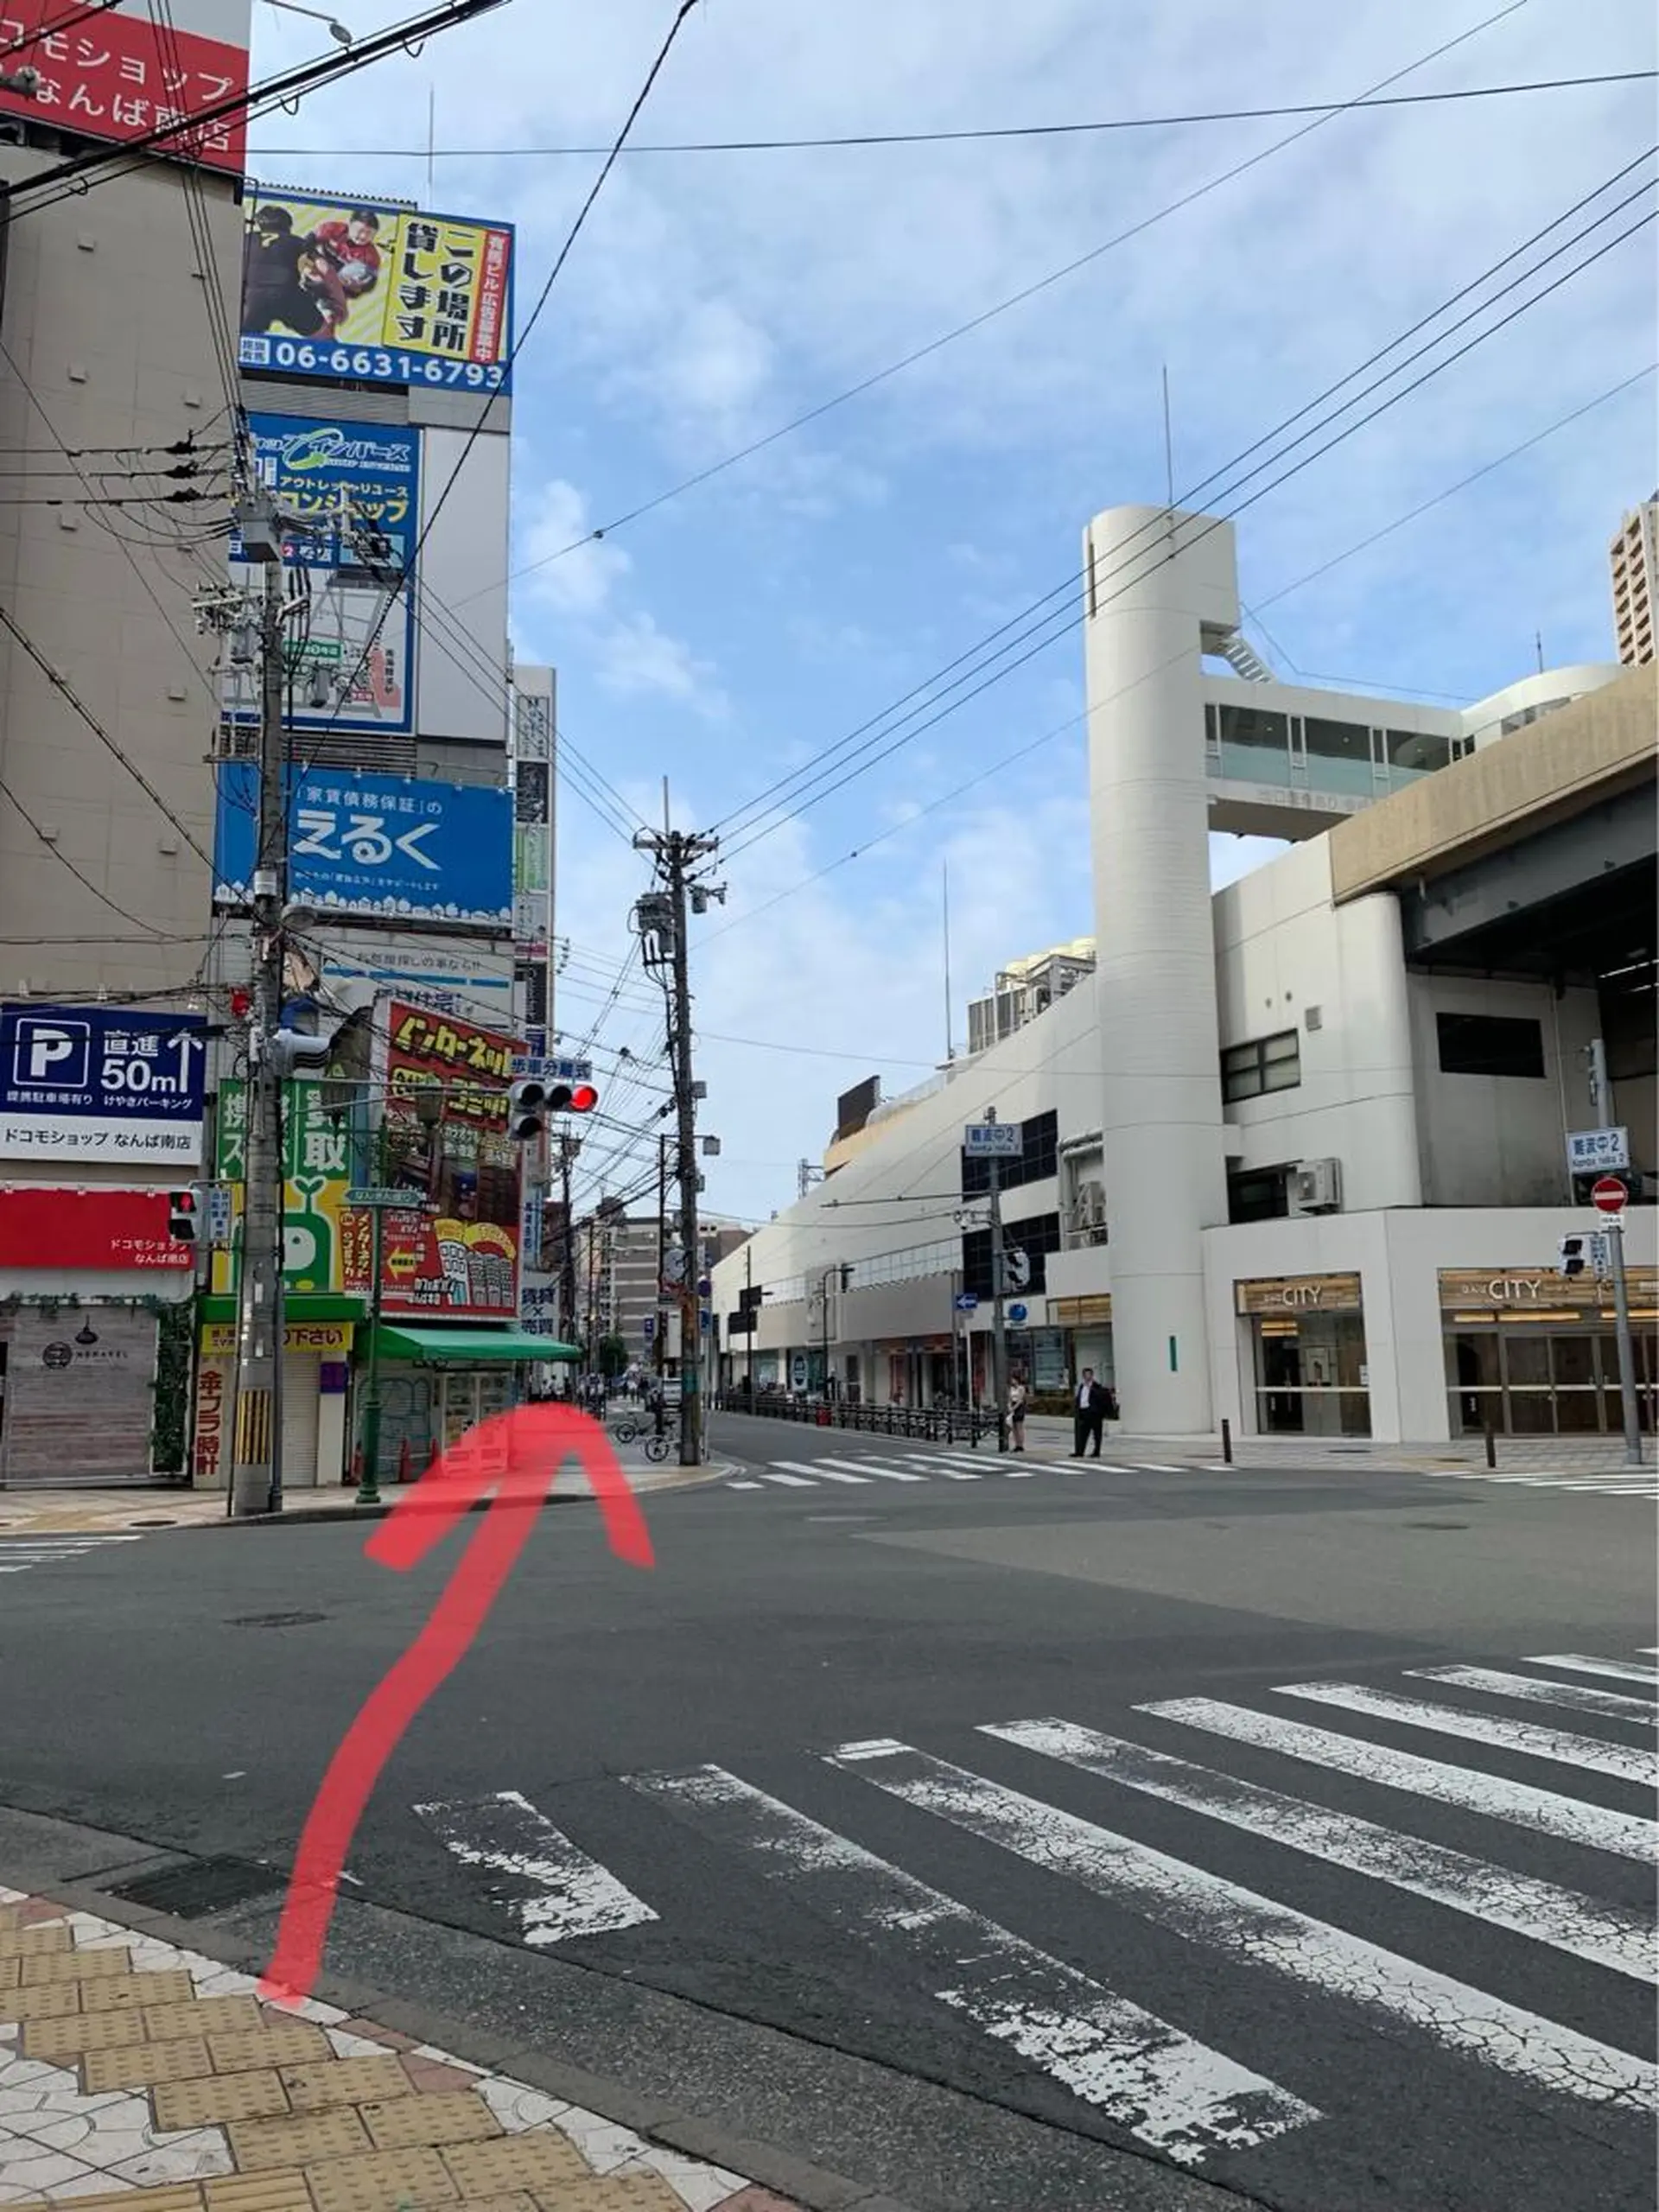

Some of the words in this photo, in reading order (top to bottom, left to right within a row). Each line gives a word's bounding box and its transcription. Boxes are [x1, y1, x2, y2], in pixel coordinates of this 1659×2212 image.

[395, 221, 439, 341] 貸します
[431, 229, 474, 352] この場所
[276, 343, 505, 388] 06-6631-6793
[293, 809, 442, 871] えるく
[103, 1030, 159, 1057] 直進
[100, 1058, 175, 1092] 50m
[512, 1058, 592, 1079] 歩車分離式
[104, 1095, 193, 1109] けやきパーキング
[5, 1128, 108, 1147] ドコモショップ
[115, 1132, 191, 1150] なんば南店
[111, 1239, 188, 1251] ドコモショップ
[135, 1253, 188, 1265] なんば南店
